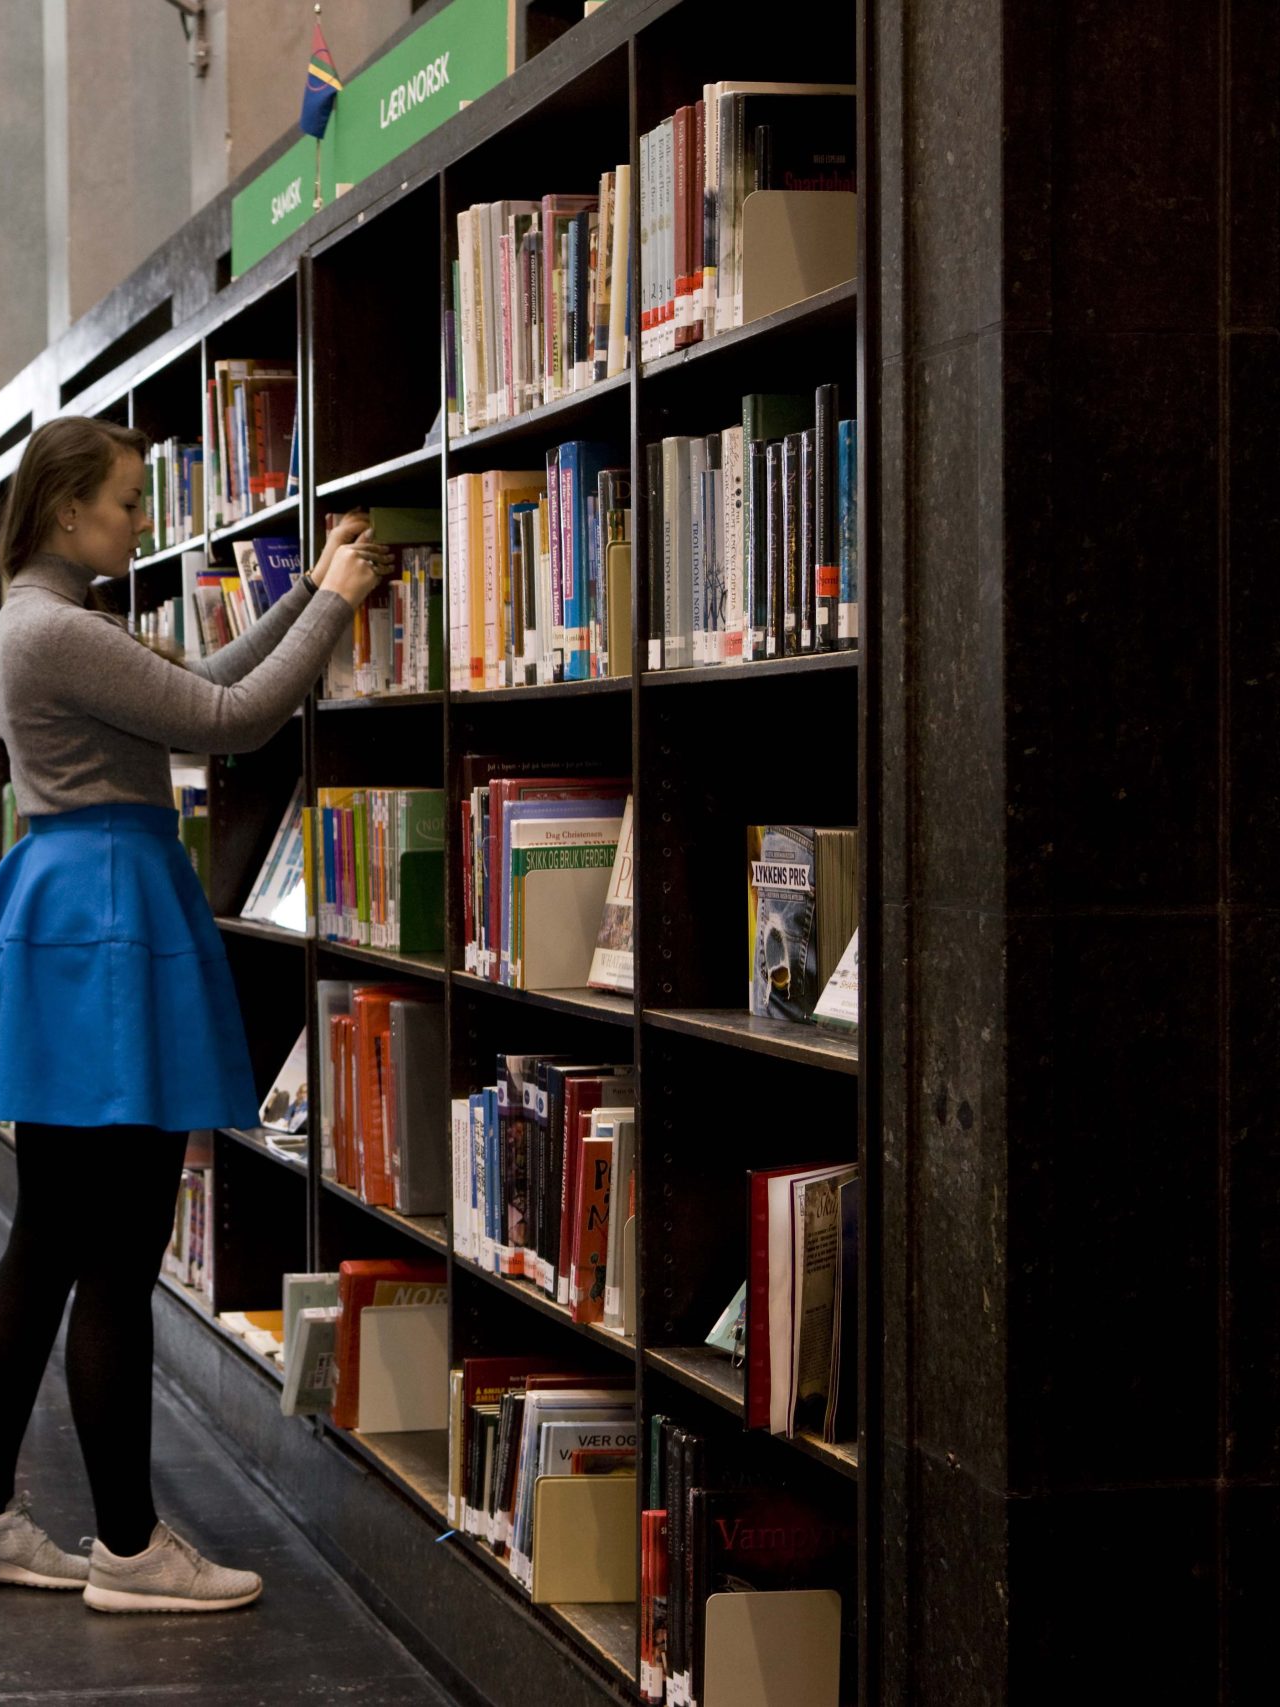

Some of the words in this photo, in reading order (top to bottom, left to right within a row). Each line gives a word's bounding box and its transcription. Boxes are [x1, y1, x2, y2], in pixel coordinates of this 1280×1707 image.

[380, 85, 406, 129] LÆR
[407, 51, 450, 111] NORSK
[271, 177, 301, 225] SAMISK
[552, 527, 557, 540] of
[546, 832, 560, 840] Dag
[562, 831, 603, 839] Christensen
[526, 850, 547, 869] SKIKK
[548, 850, 559, 868] OG
[560, 850, 579, 868] BRUK
[580, 849, 609, 868] VERDEN
[755, 864, 788, 885] LYKKENS
[788, 867, 807, 887] PRIS
[392, 1286, 448, 1306] NOR
[578, 1434, 611, 1446] VÆR
[615, 1434, 637, 1446] OG
